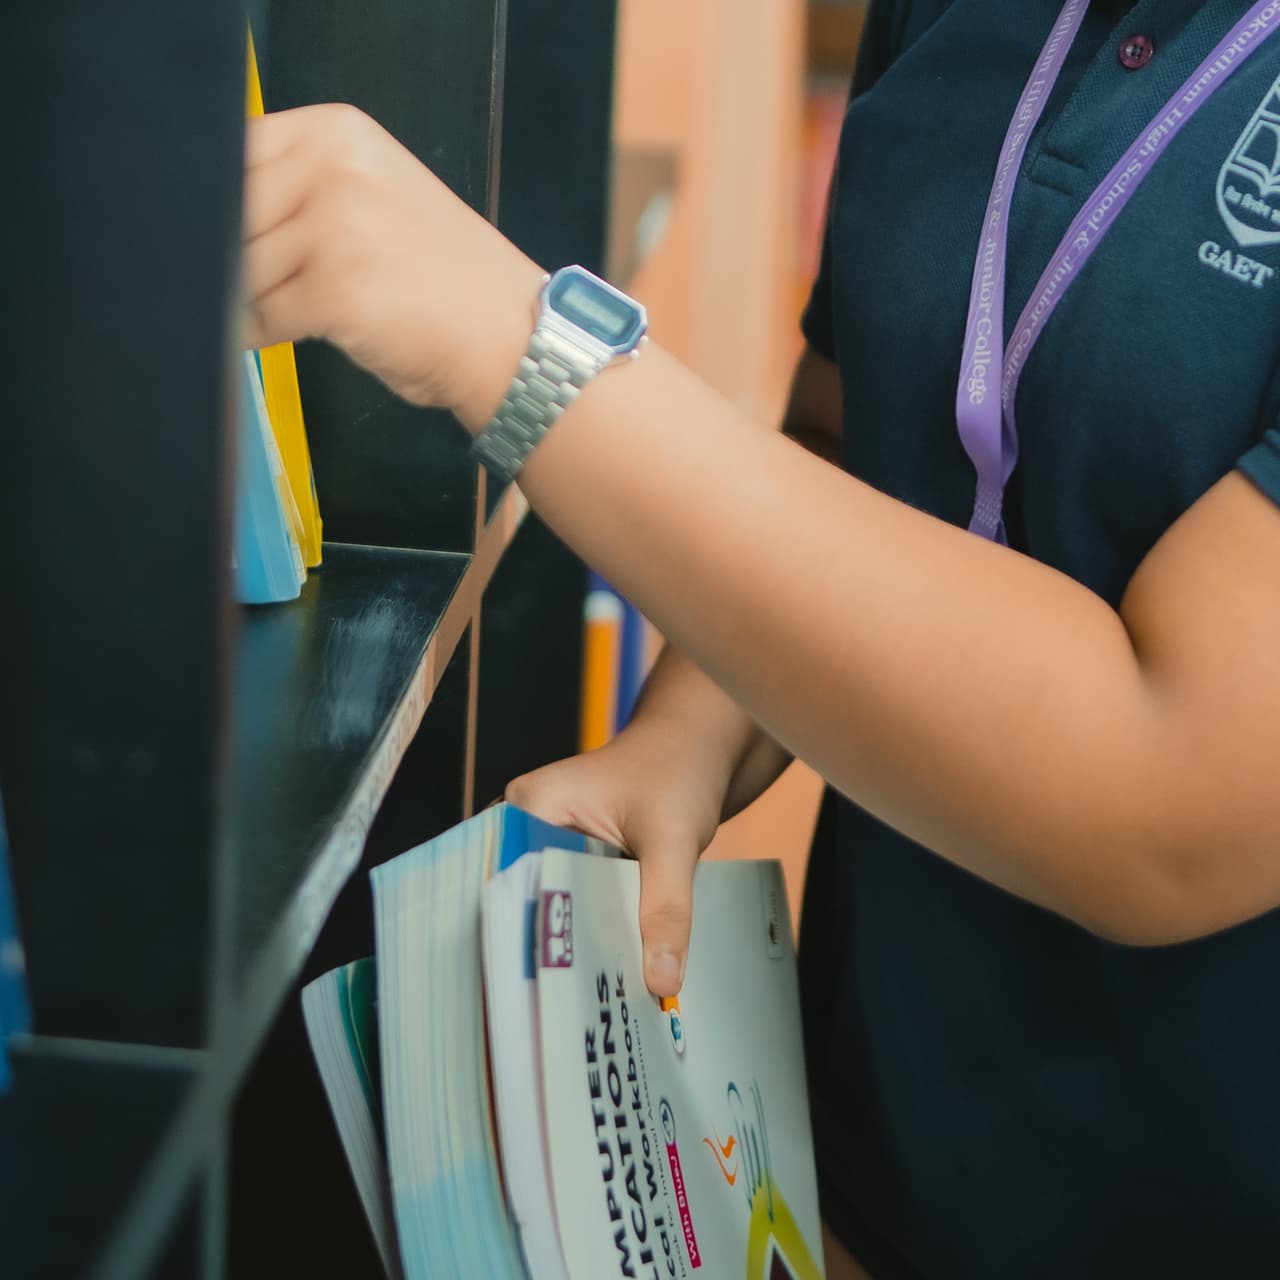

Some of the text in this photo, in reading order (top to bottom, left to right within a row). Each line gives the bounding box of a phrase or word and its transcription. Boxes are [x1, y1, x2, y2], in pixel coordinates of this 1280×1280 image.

[1016, 80, 1045, 130] High
[1139, 107, 1183, 157] High
[993, 133, 1025, 204] School
[1086, 159, 1143, 232] School
[989, 211, 1000, 230] &
[1073, 231, 1091, 251] &
[979, 238, 996, 313] Junior
[1031, 255, 1072, 328] Junior
[1198, 241, 1274, 288] GAET
[967, 318, 993, 406] College
[616, 970, 657, 1202] Workbook
[596, 969, 659, 1280] ICATIONS
[671, 1154, 697, 1261] With BlueJ
